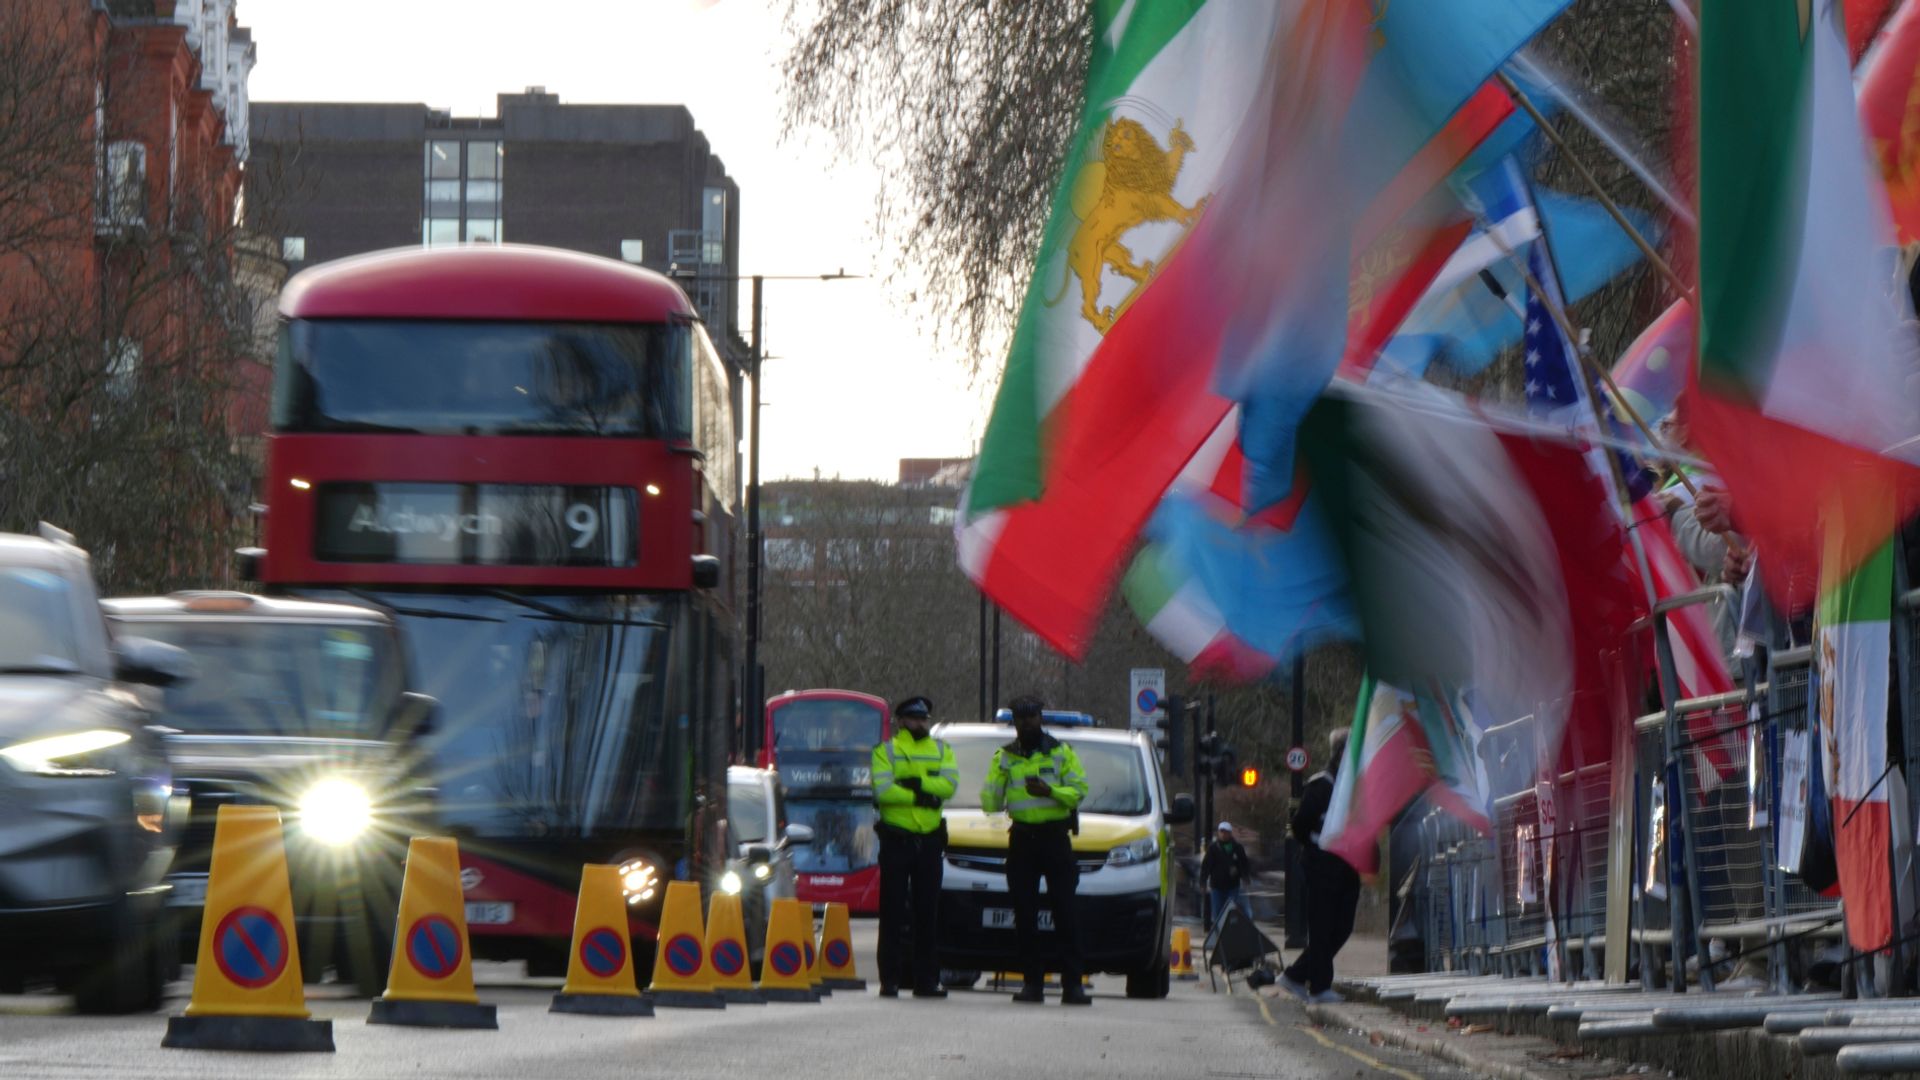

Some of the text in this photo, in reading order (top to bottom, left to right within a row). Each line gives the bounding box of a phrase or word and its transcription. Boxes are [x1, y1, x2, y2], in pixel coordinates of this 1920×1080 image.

[565, 503, 599, 549] 9
[1290, 752, 1305, 764] 20
[791, 767, 871, 785] Victoria 52
